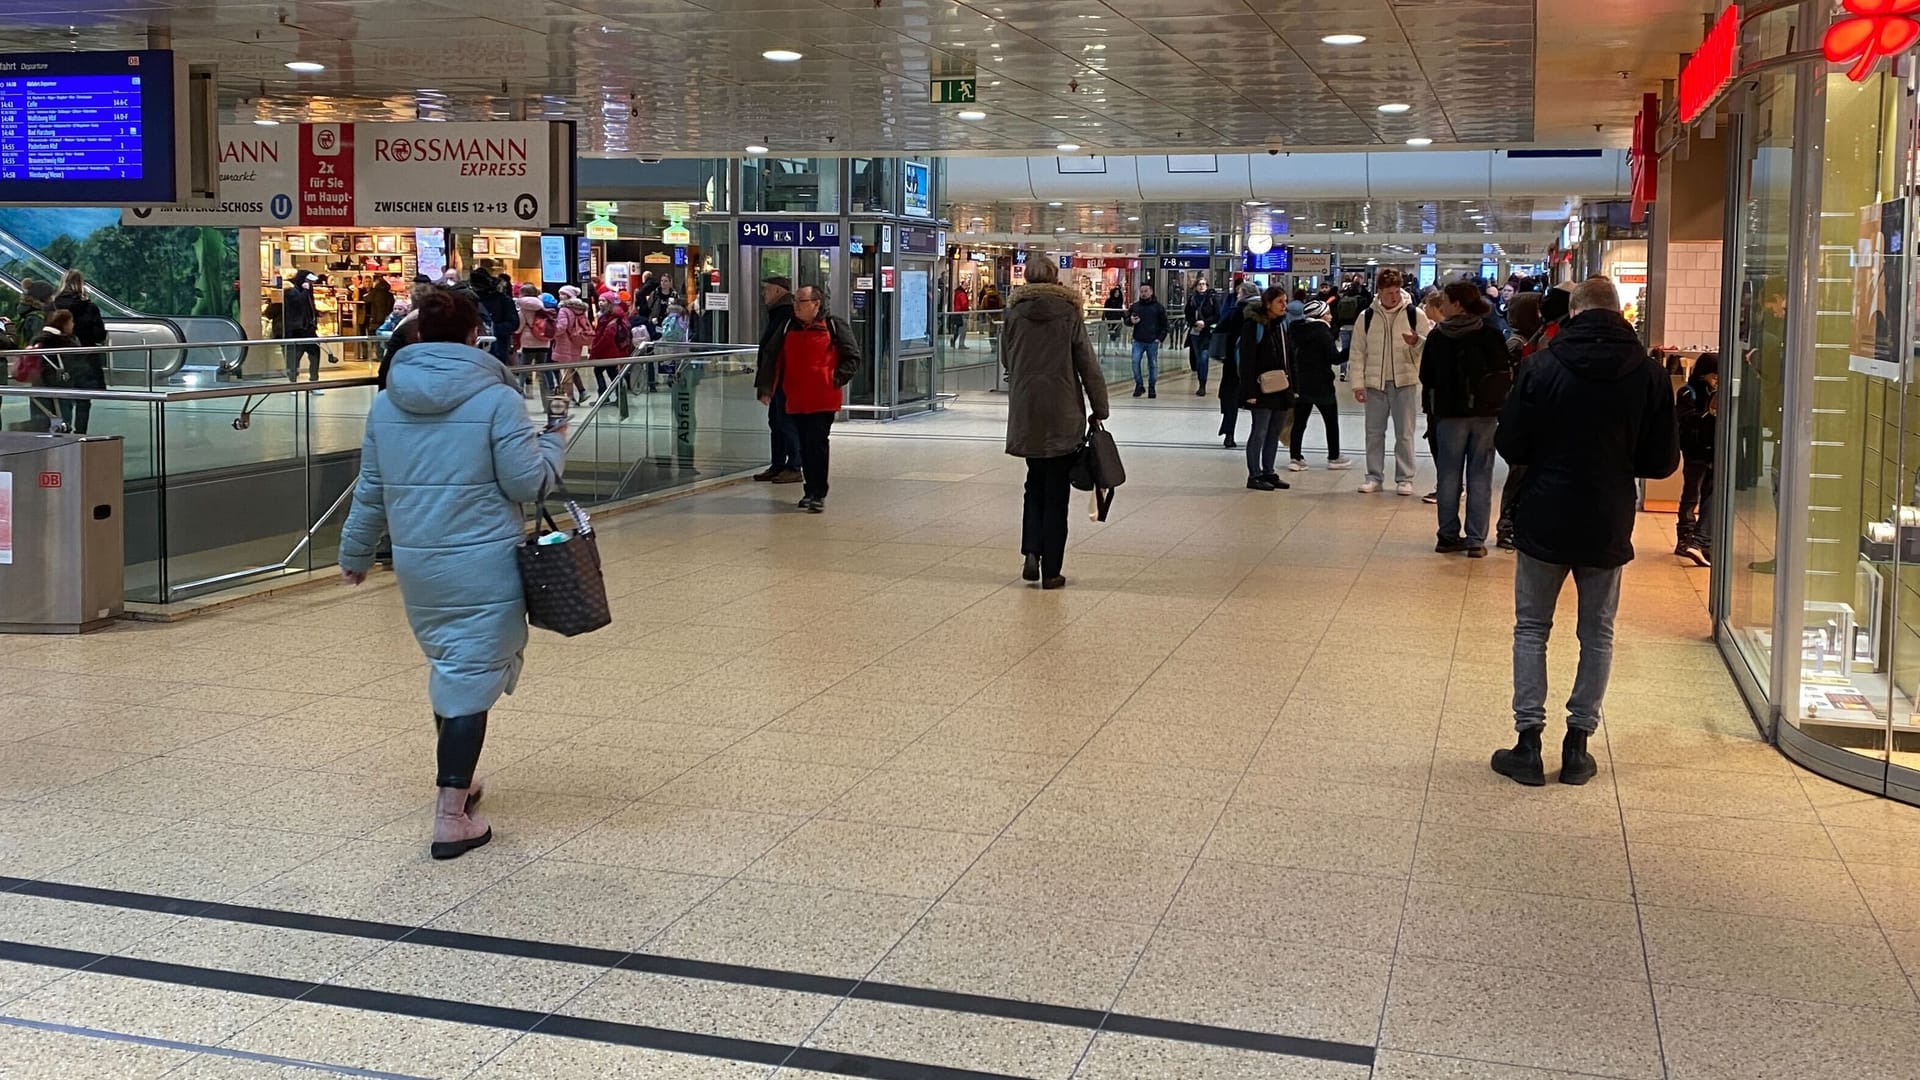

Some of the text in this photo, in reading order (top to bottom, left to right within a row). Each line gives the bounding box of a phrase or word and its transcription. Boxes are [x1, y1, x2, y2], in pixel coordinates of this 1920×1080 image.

[218, 141, 278, 163] ANN
[375, 138, 527, 162] ROSSMANN
[318, 161, 335, 175] 2x
[460, 163, 528, 176] EXPRESS
[310, 177, 344, 188] für Sie
[304, 191, 352, 204] im Haupt-
[275, 198, 287, 215] U
[307, 205, 348, 217] bahnhof
[374, 201, 433, 213] ZWISCHEN
[436, 201, 469, 213] GLEIS
[743, 223, 769, 237] 9-10
[826, 224, 834, 235] U
[1061, 256, 1067, 265] 3
[1163, 258, 1177, 266] 7-8
[678, 392, 690, 444] Abfall
[41, 474, 60, 487] DB
